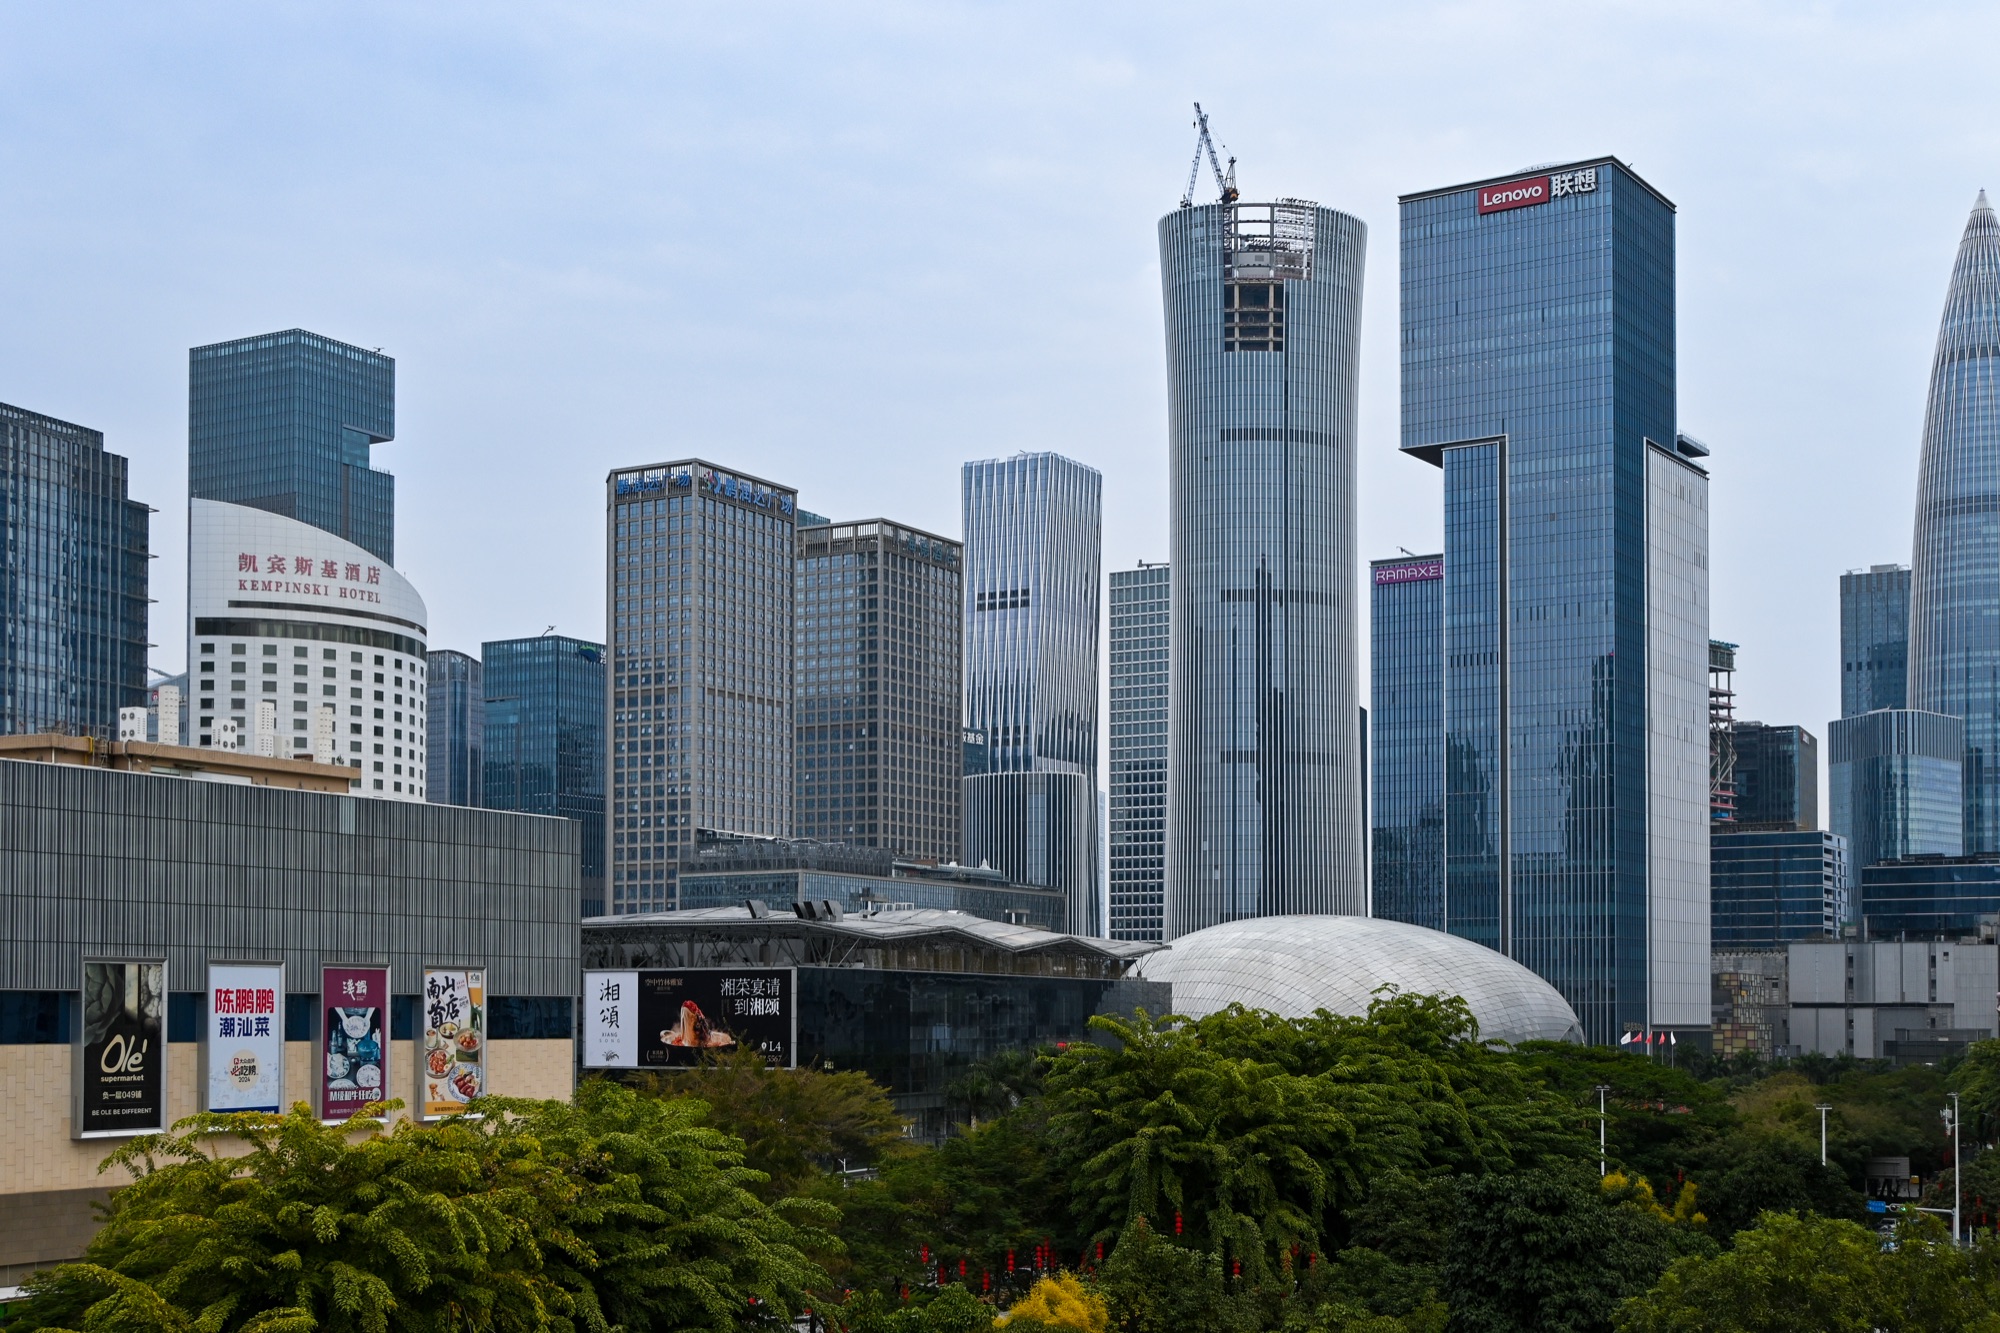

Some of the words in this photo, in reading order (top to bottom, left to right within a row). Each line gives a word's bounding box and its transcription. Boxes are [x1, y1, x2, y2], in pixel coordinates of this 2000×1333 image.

[1551, 167, 1596, 197] 联想
[1483, 185, 1543, 207] Lenovo
[617, 470, 690, 494] 鹏润达广场
[725, 477, 793, 515] 鹏润达广场
[238, 552, 381, 586] 凯宾斯基酒店
[238, 579, 329, 596] KEMPINSKI
[339, 586, 381, 604] HOTEL
[720, 978, 780, 996] 湘菜宴请
[215, 988, 274, 1014] 陈鹏鹏
[735, 997, 780, 1016] 到湘颂
[219, 1016, 270, 1037] 潮汕菜
[769, 1041, 781, 1051] L4
[101, 1074, 144, 1082] supermarket
[230, 1065, 257, 1076] 必吃榜
